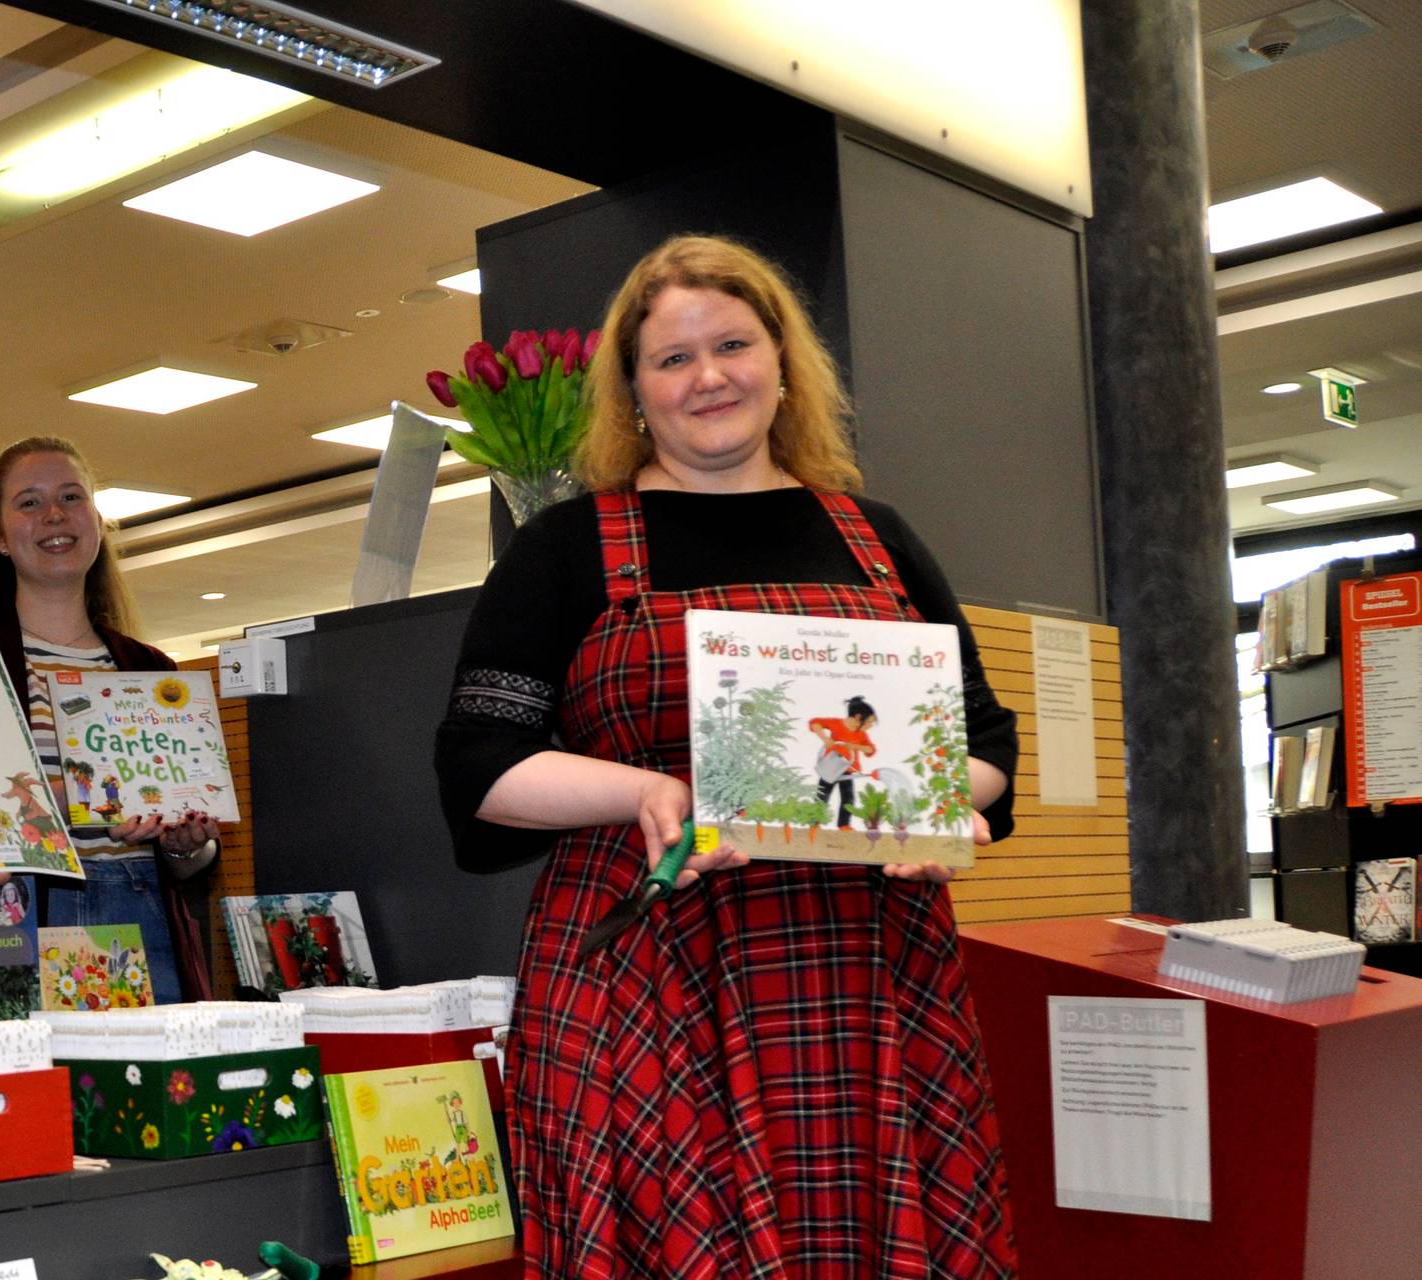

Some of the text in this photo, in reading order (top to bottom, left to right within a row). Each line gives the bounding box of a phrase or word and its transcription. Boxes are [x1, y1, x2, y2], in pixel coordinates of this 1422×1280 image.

[1361, 599, 1409, 611] Bestseller
[705, 637, 946, 669] Was wächst denn da?
[105, 712, 194, 727] kunterbuntes
[114, 700, 144, 711] Mein
[85, 723, 201, 757] Garten-
[114, 755, 187, 784] Buch
[385, 1134, 421, 1156] Mein
[357, 1154, 499, 1214] Garten
[430, 1201, 502, 1231] AlphaBeet
